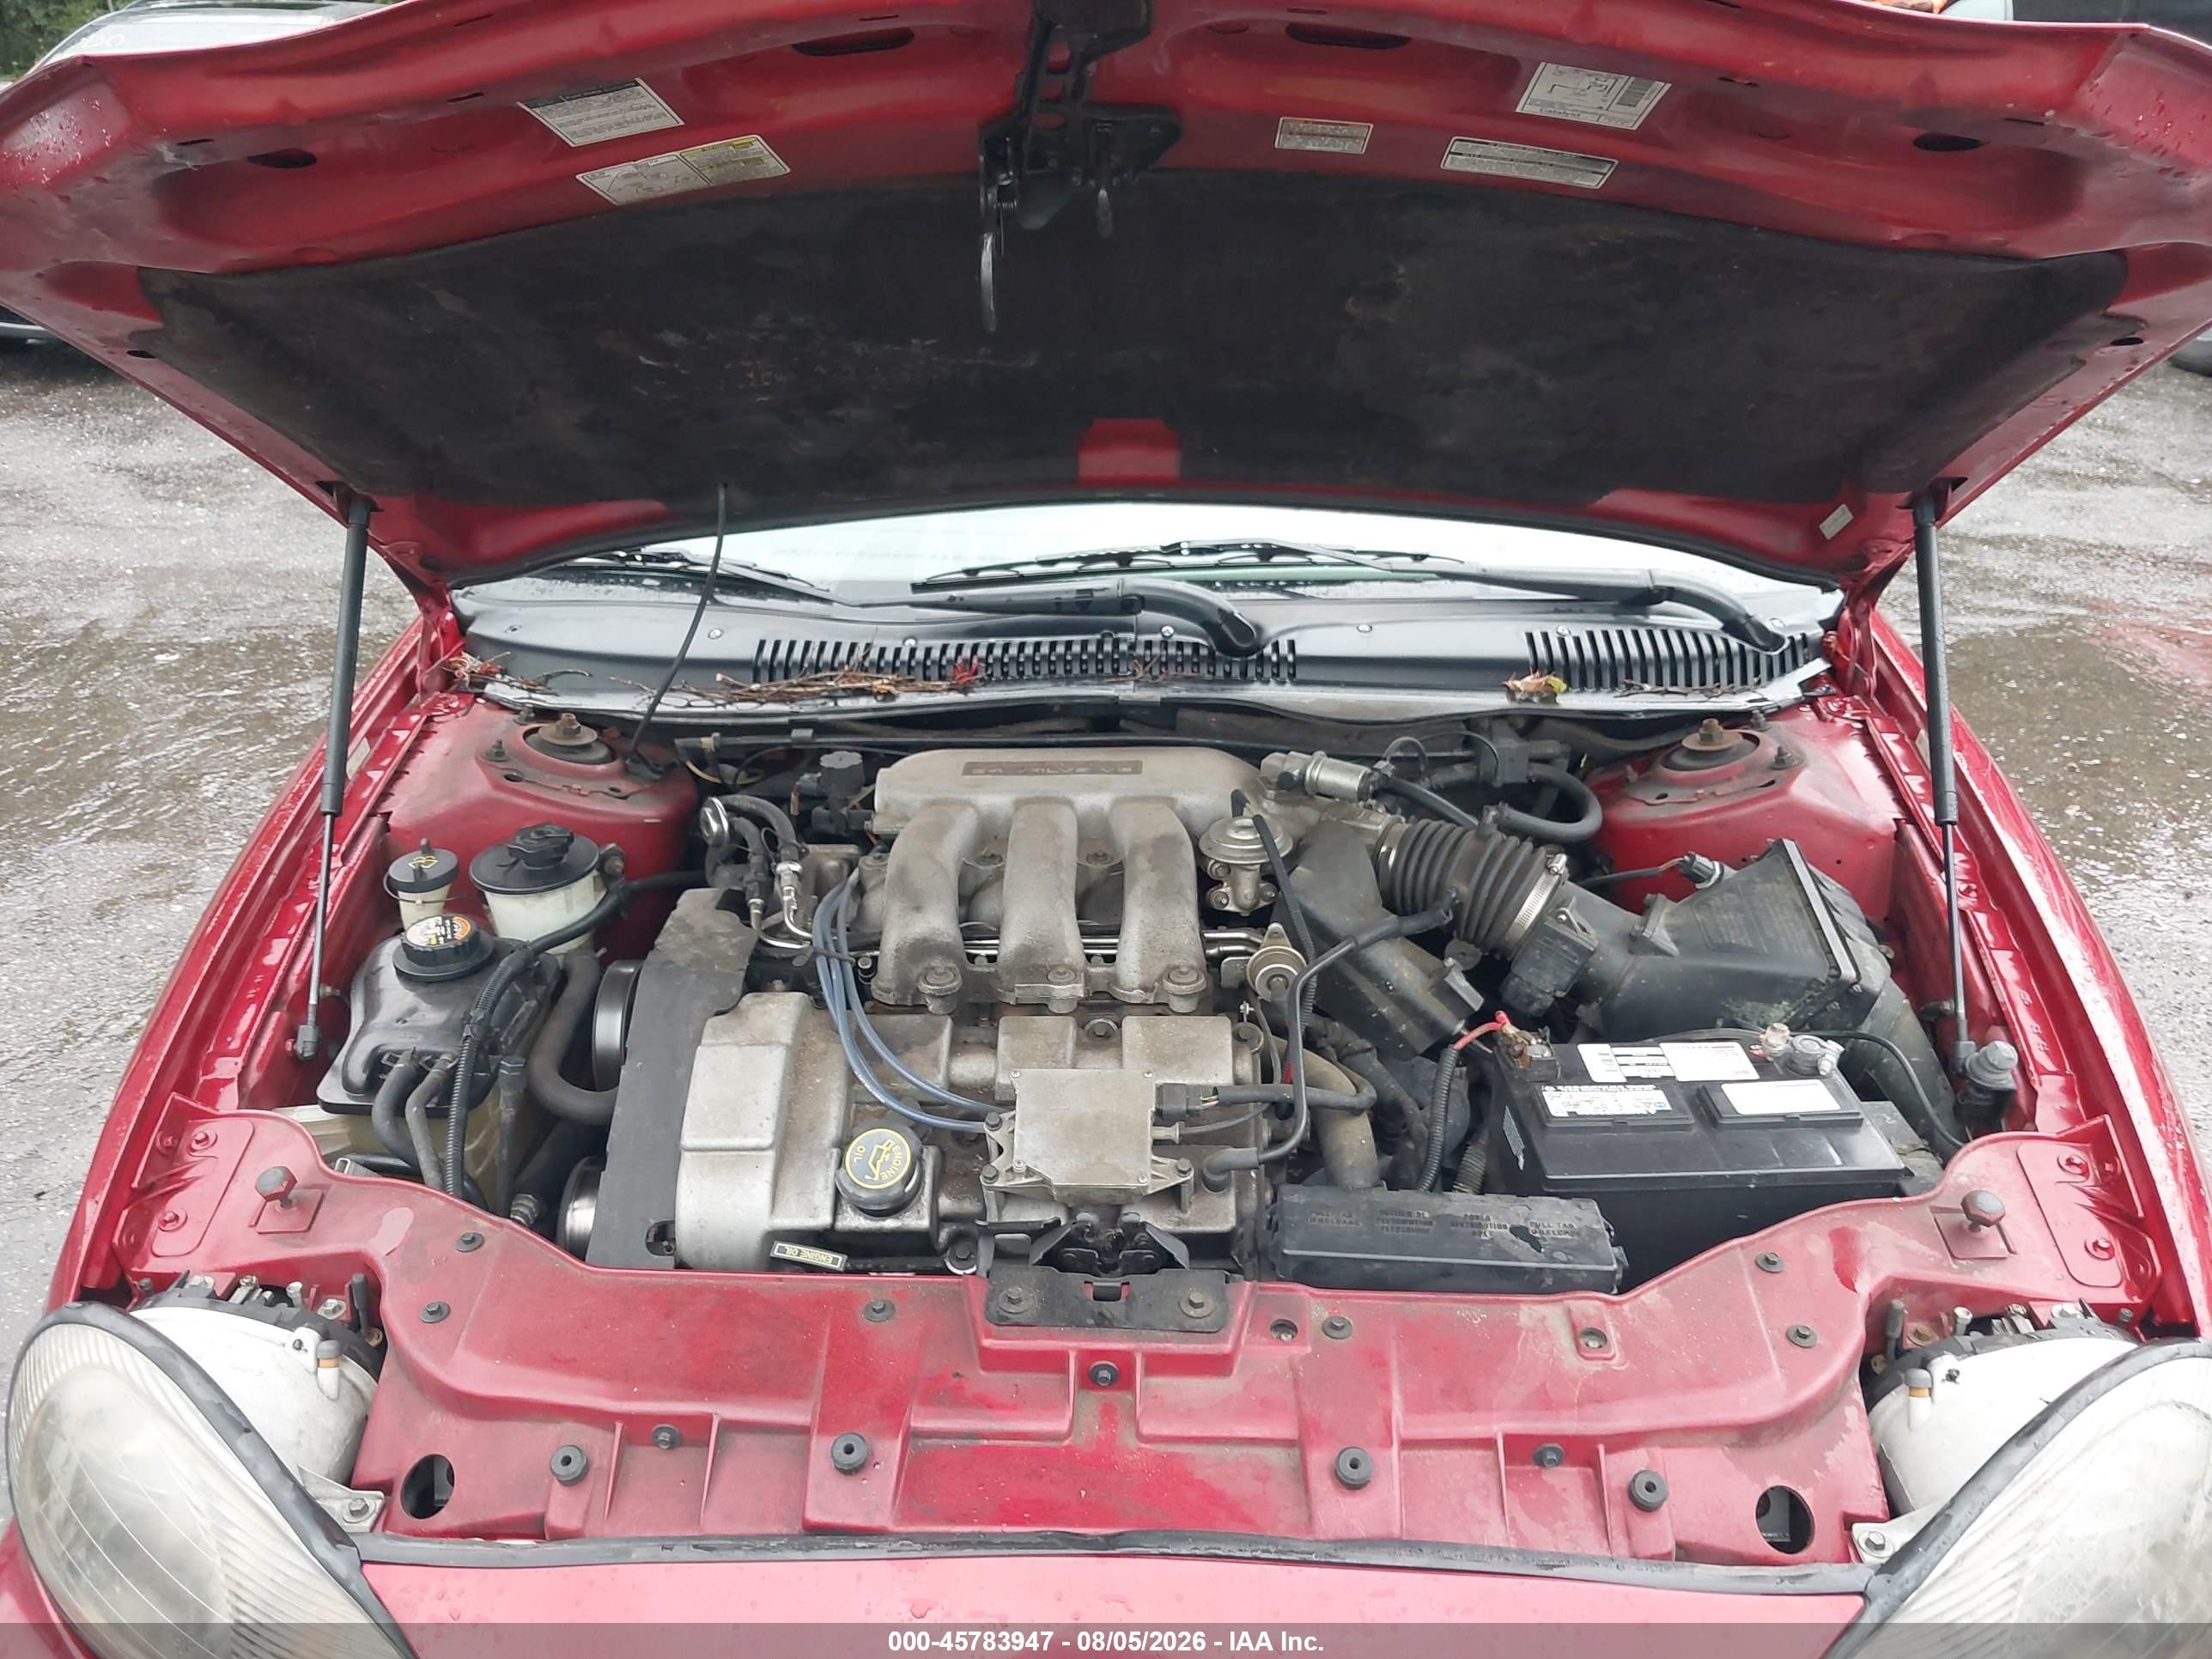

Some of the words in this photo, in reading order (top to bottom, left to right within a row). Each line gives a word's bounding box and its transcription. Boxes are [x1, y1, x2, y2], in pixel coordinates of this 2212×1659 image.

[854, 1146, 866, 1163] OIL
[879, 1145, 902, 1179] ENGINE
[784, 1246, 799, 1256] OIL
[799, 1249, 833, 1264] ENGINE
